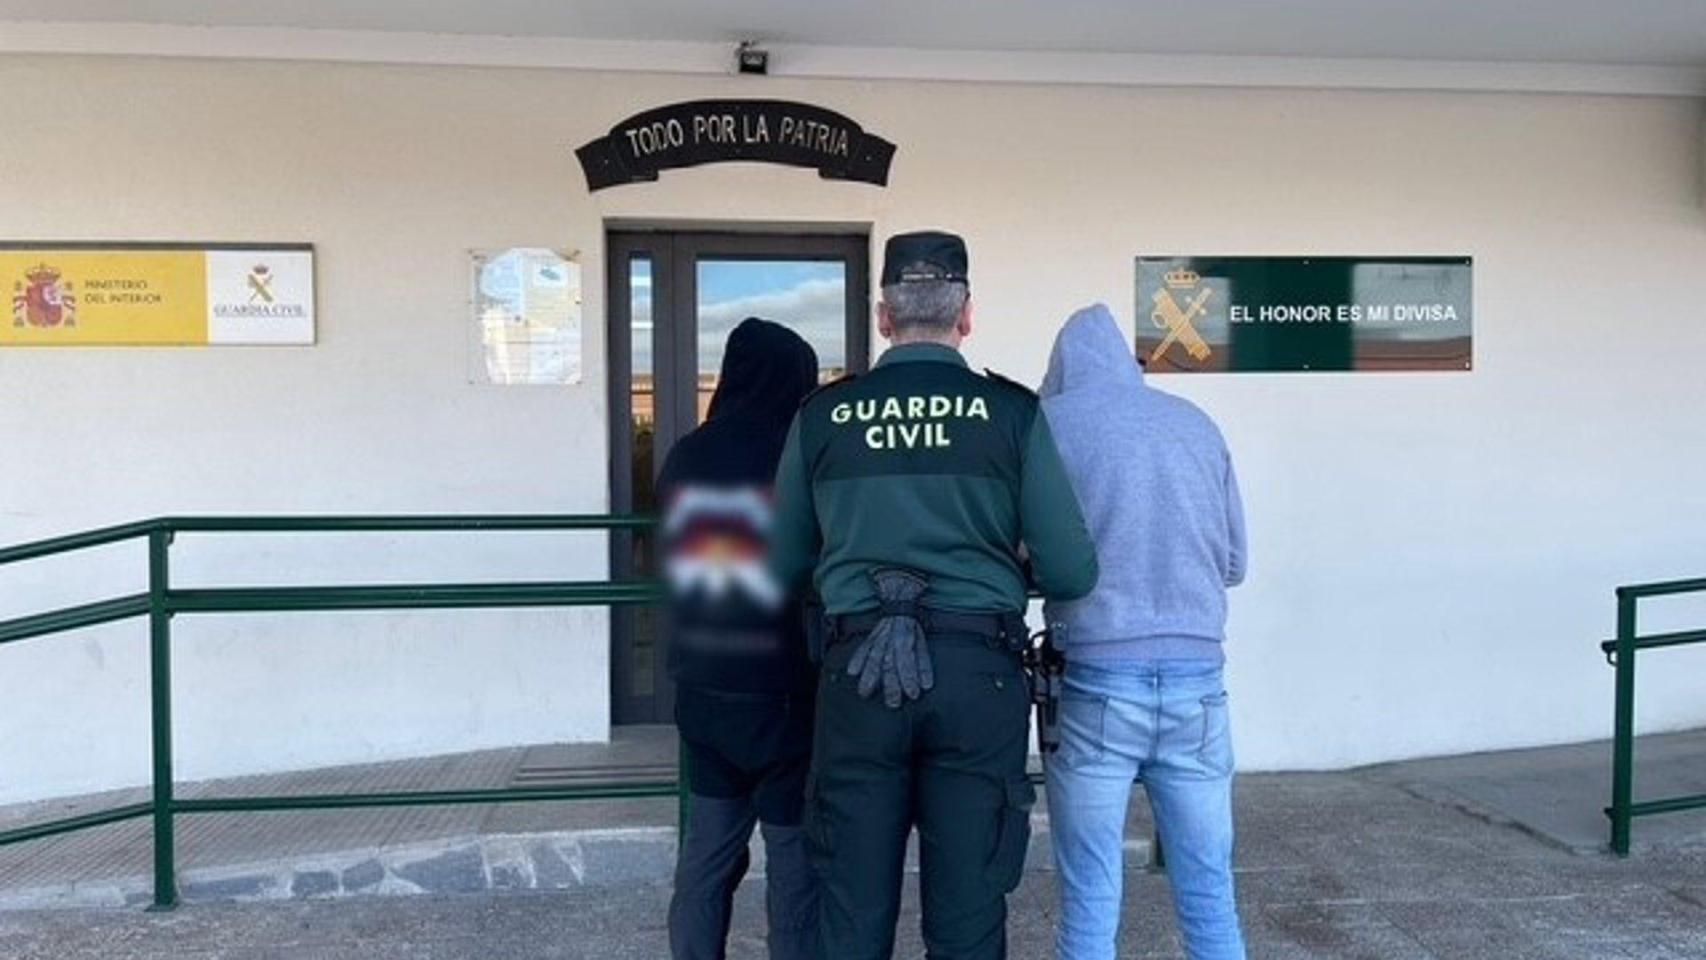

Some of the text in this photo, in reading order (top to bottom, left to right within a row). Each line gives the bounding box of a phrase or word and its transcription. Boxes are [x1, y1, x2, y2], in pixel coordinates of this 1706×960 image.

[626, 113, 850, 158] TODO POR LA PATRIA
[84, 279, 148, 291] MINISTERIO
[84, 292, 162, 304] DEL INTERIOR
[213, 304, 305, 317] GUARDIA CIVIL
[1229, 303, 1457, 322] EL HONOR ES MI DIVISA
[831, 395, 990, 423] GUARDIA
[864, 423, 951, 449] CIVIL
